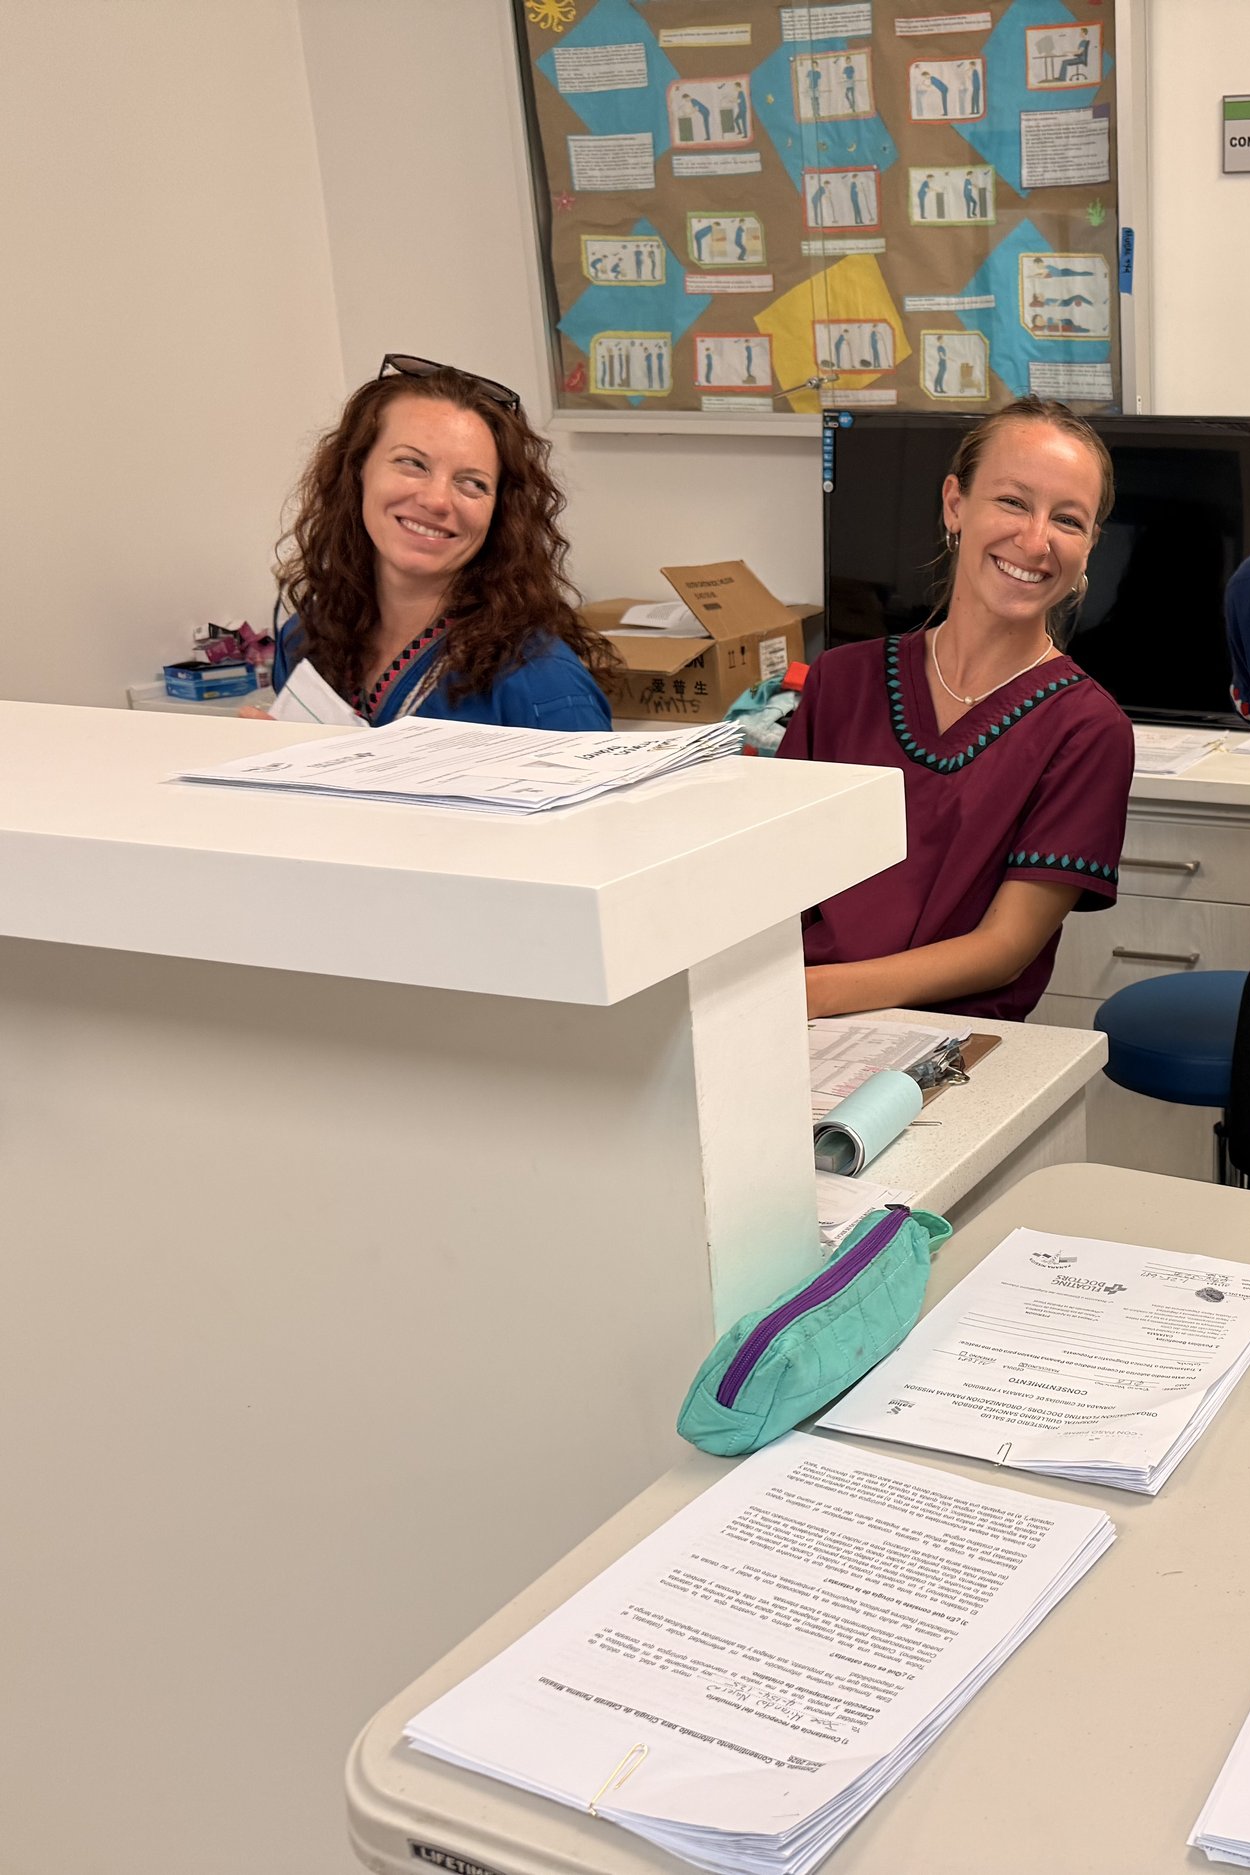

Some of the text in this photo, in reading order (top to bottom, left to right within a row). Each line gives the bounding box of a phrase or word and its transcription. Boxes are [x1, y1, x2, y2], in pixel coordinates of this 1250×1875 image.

[1049, 1278, 1103, 1292] FLOATING
[1054, 1274, 1106, 1287] DOCTORS
[1007, 1376, 1088, 1396] CONSENTIMIENTO
[1025, 1406, 1064, 1417] DOCTORS
[420, 1846, 491, 1875] LIFETIM
